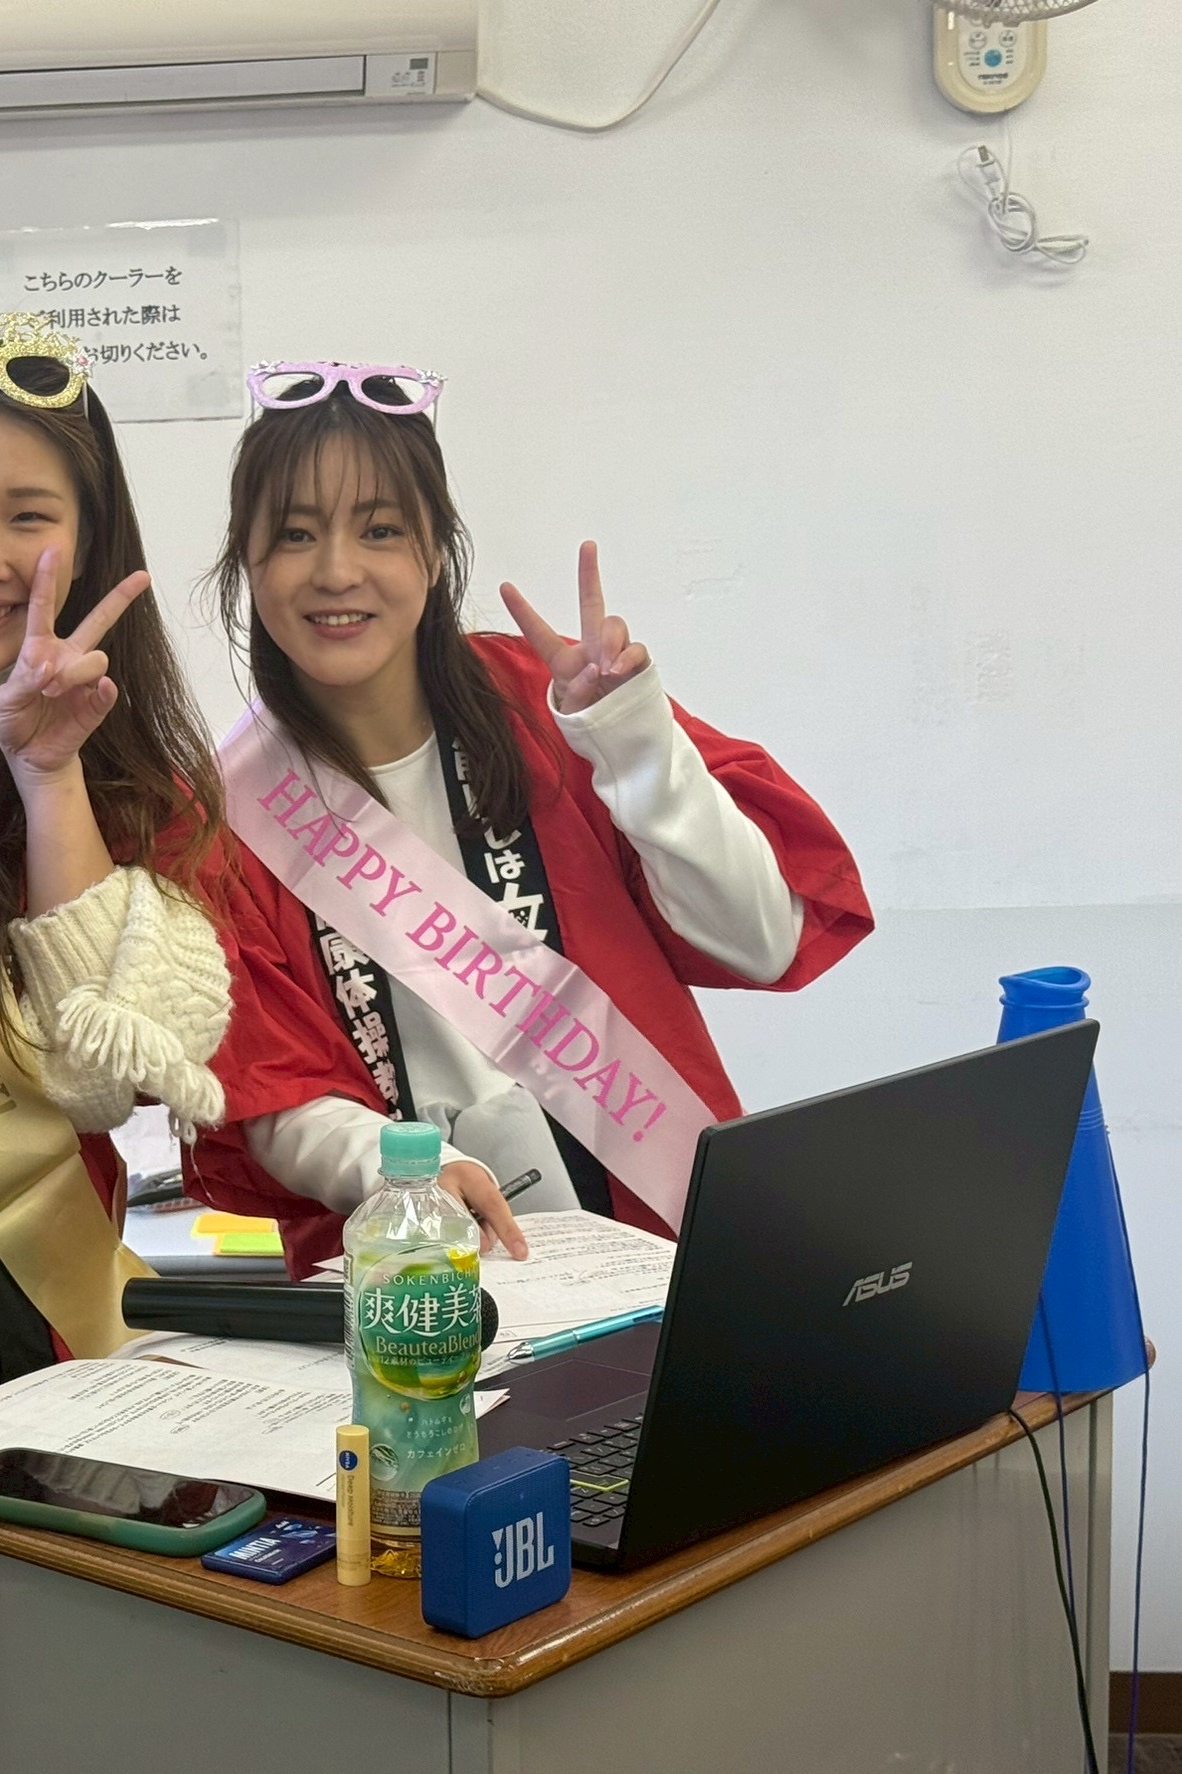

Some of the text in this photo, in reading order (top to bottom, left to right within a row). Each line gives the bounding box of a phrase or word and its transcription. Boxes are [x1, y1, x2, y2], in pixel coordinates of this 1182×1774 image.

[23, 265, 183, 292] こちらのクーラーを
[258, 769, 422, 917] HAPPY
[406, 901, 667, 1143] BIRTHDAY!
[842, 1261, 913, 1307] ASUS
[407, 1443, 466, 1459] カフェインゼロ
[492, 1511, 555, 1589] JBL
